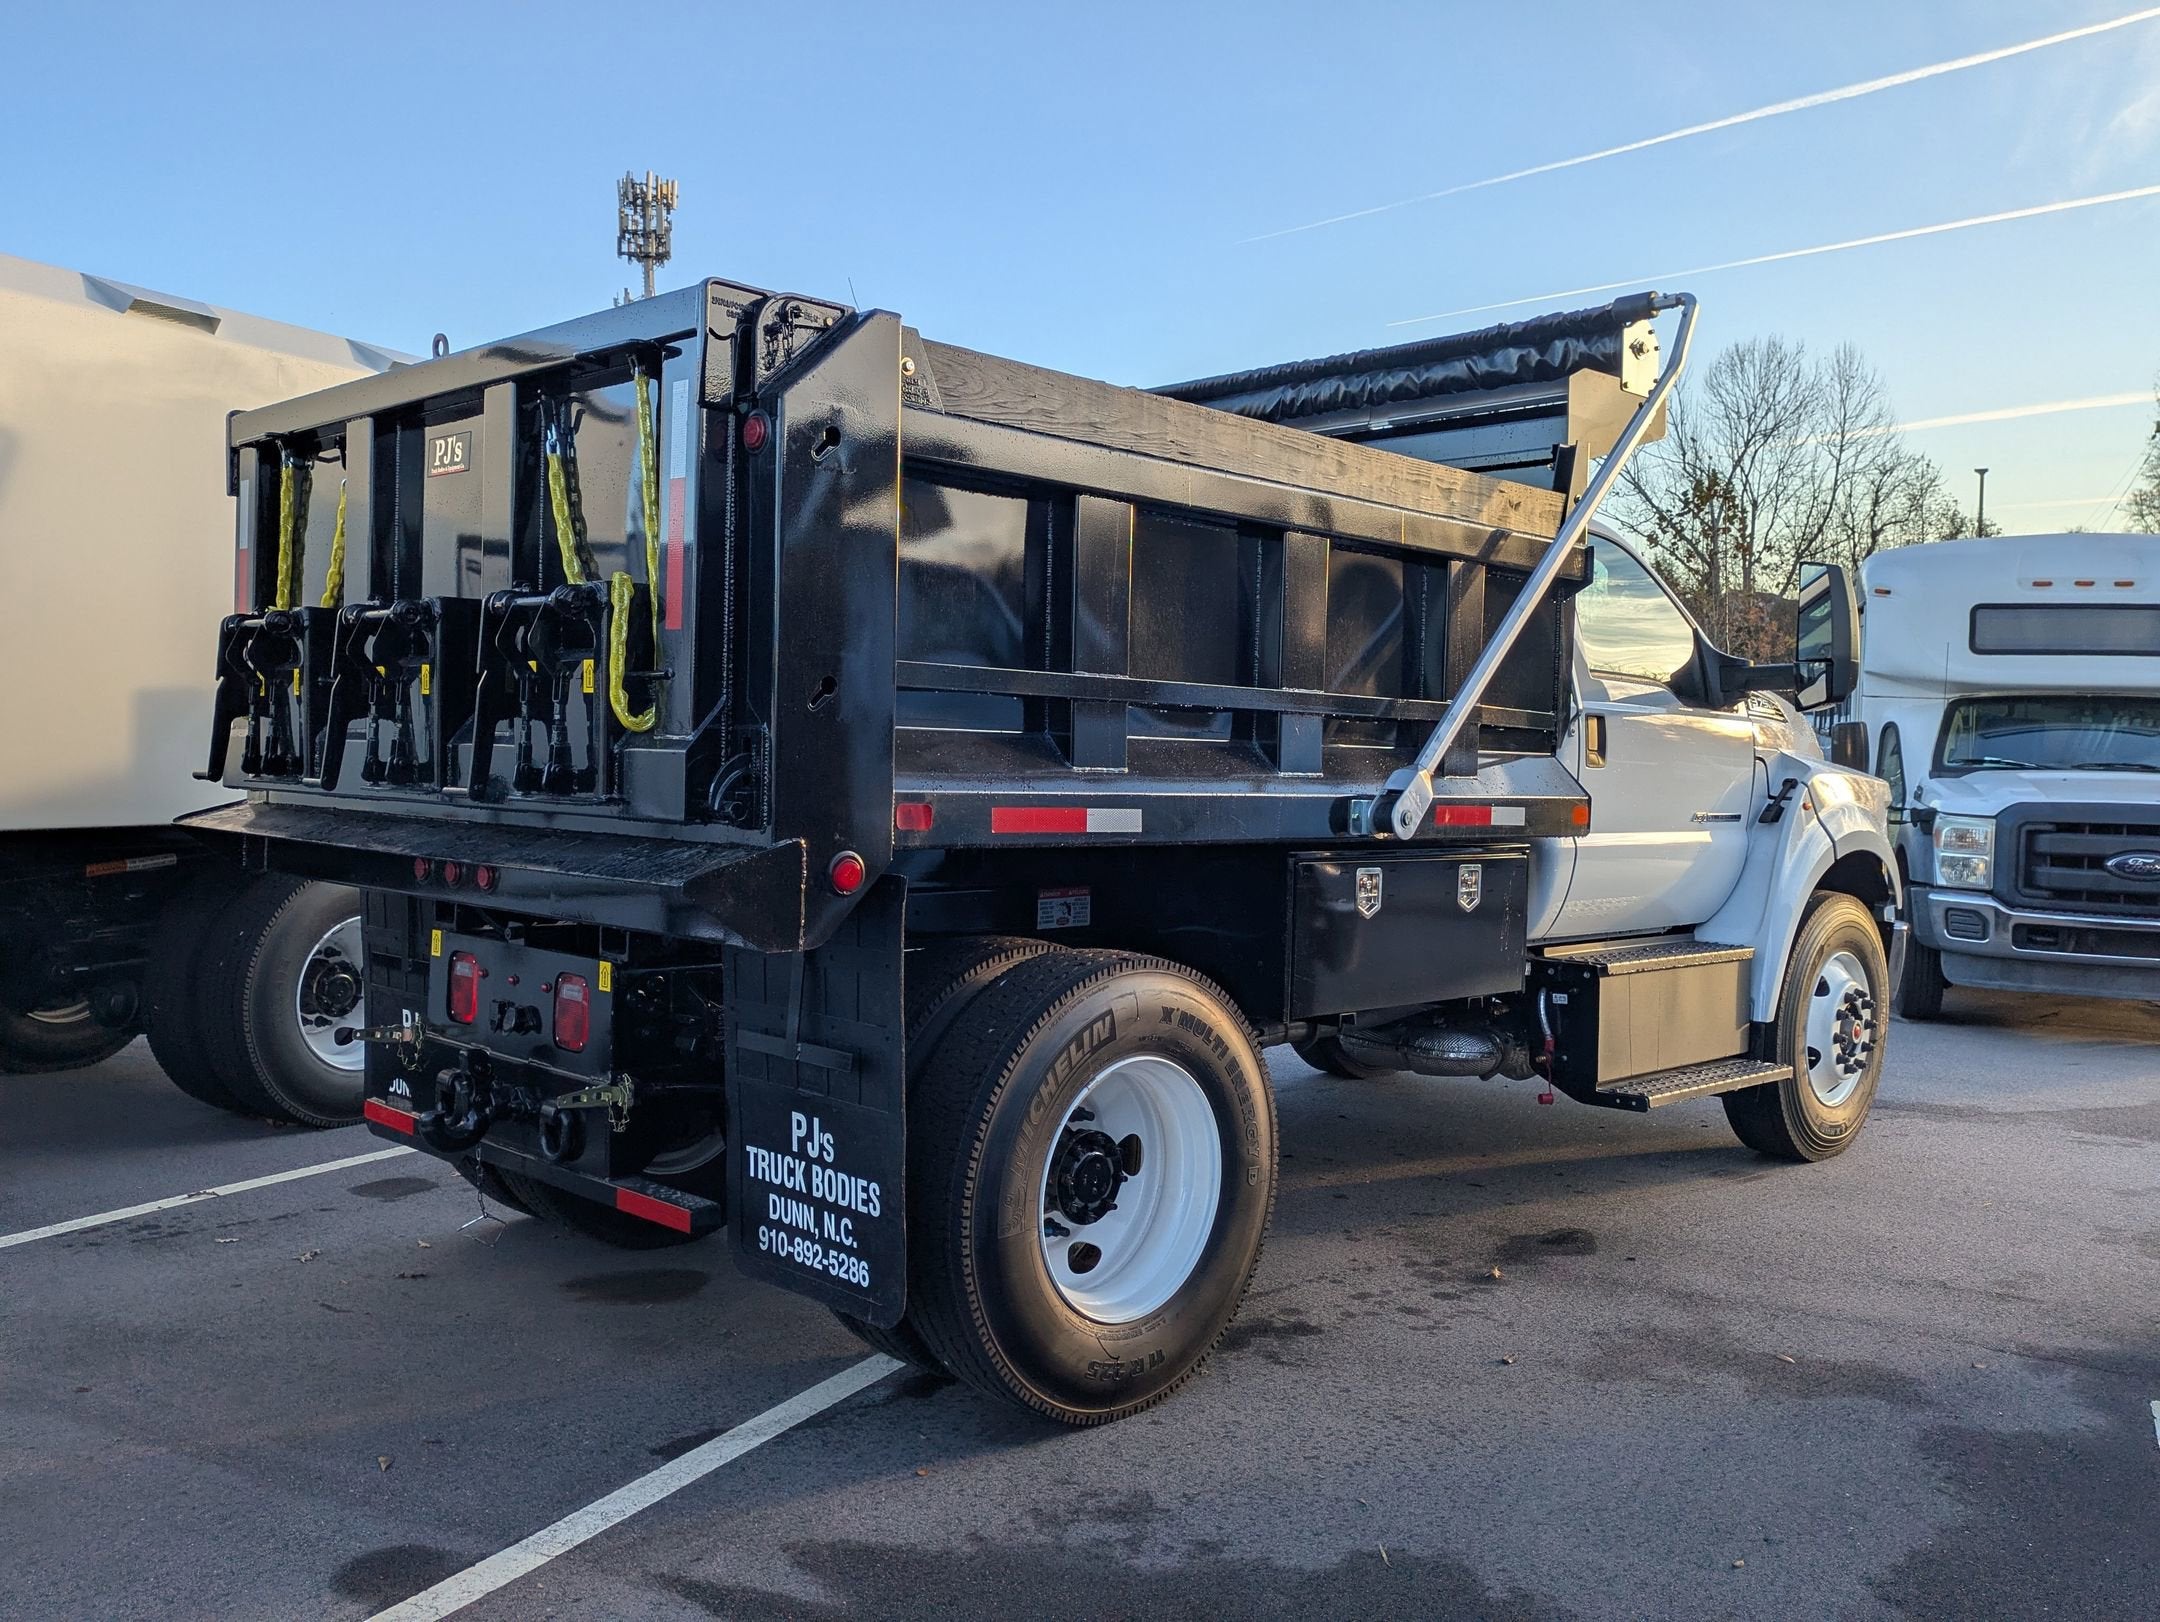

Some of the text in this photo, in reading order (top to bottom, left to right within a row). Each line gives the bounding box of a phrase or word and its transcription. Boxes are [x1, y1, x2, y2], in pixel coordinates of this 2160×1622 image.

[434, 435, 463, 466] PJ's
[1010, 1014, 1112, 1177] MICHELIN
[791, 1110, 835, 1163] PJ's
[745, 1145, 881, 1218] TRUCK BODIES
[768, 1193, 858, 1249] DUNN, N.C.
[758, 1225, 870, 1288] 910-892-5286
